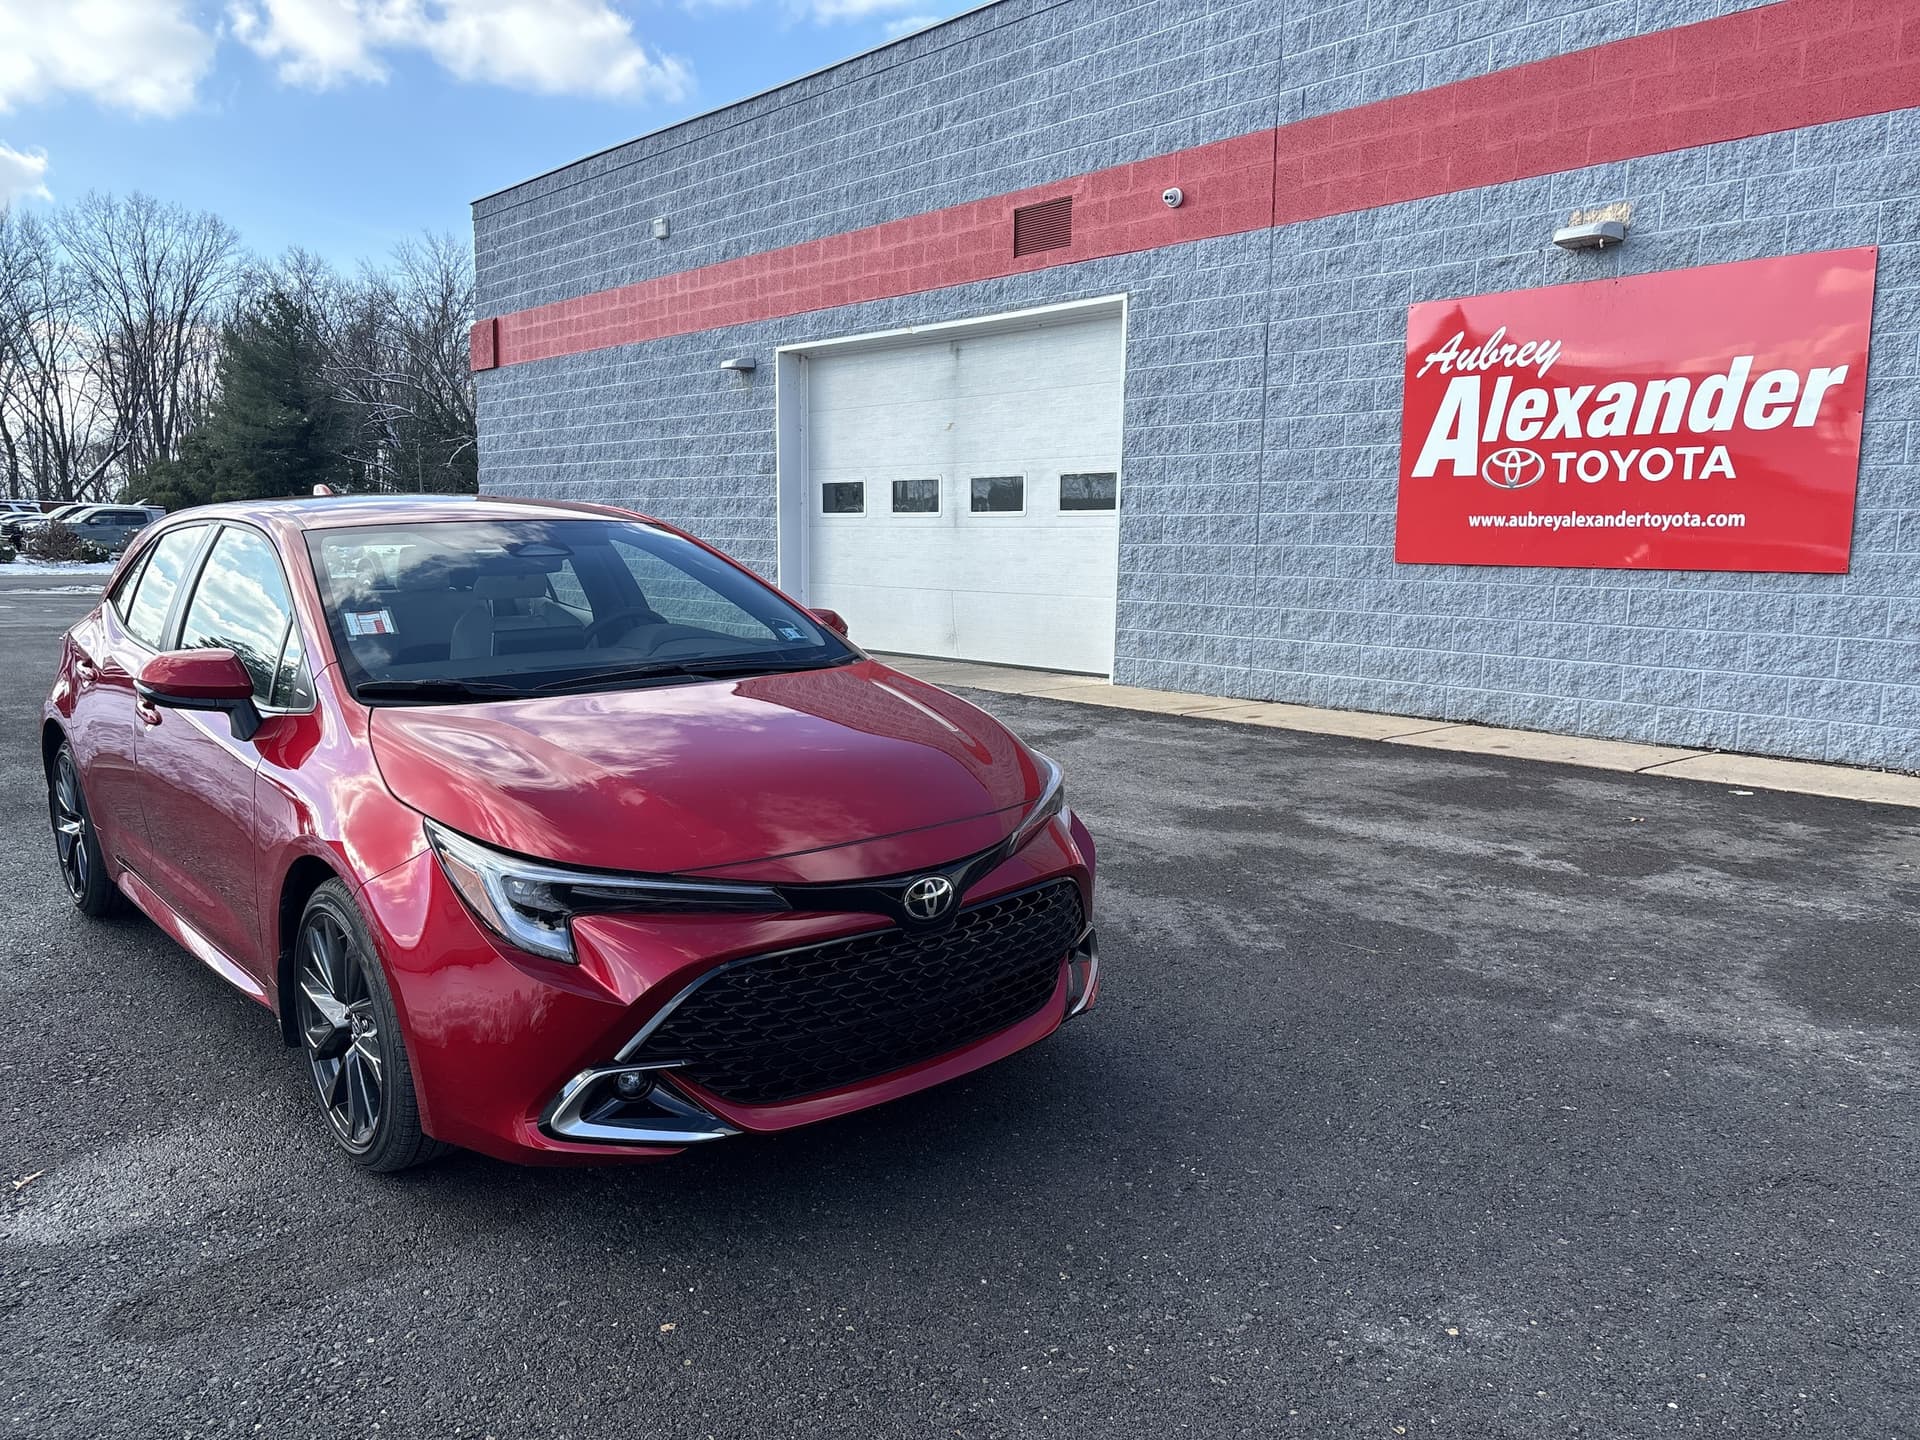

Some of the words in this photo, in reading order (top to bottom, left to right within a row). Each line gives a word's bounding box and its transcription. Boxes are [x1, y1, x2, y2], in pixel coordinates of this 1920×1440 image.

[1416, 326, 1562, 378] Aubrey
[1411, 355, 1849, 477] Alexander
[1551, 446, 1737, 483] TOYOTA
[1468, 510, 1746, 532] www.aubreyalexandertoyota.com
